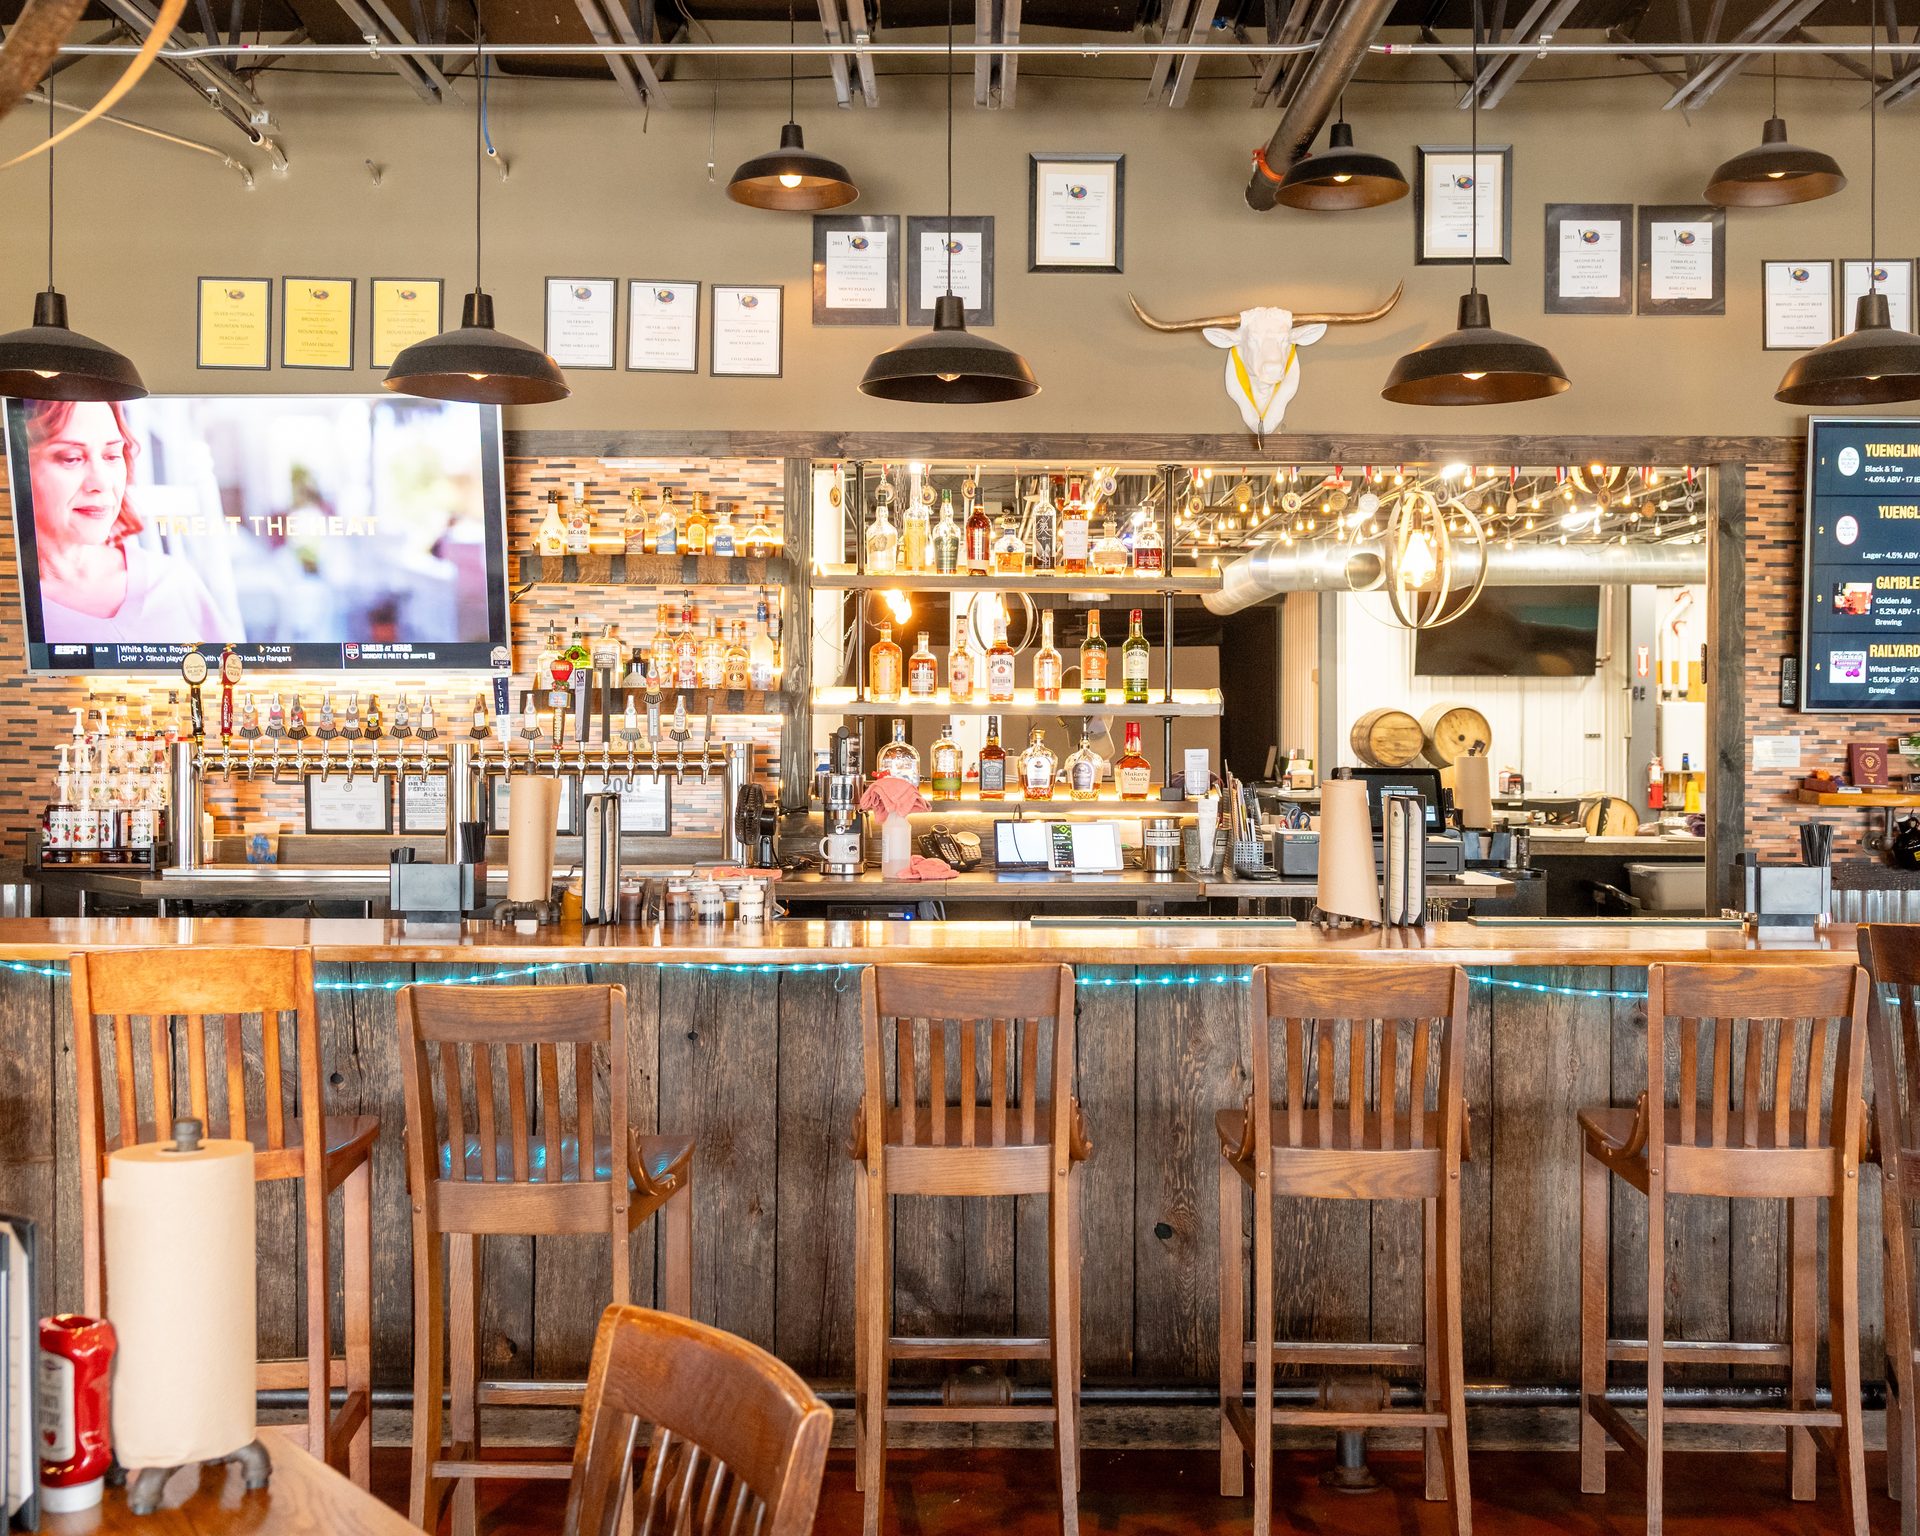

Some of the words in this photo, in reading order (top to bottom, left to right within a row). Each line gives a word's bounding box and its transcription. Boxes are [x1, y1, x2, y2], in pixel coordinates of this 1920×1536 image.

[154, 515, 241, 537] TREAT
[249, 516, 299, 537] THE
[311, 516, 378, 537] HEAT
[1818, 526, 1824, 534] 2
[1862, 552, 1882, 560] Lager
[1876, 576, 1920, 590] GAMBLE
[1816, 594, 1822, 603] 3
[1875, 597, 1899, 605] Golden
[1899, 597, 1912, 605] Ale
[54, 645, 87, 655] ESPN
[120, 645, 142, 653] White
[143, 645, 157, 653] Sox
[1126, 650, 1148, 658] JAMESON
[257, 655, 265, 664] by
[266, 655, 292, 664] Rangers
[1814, 663, 1821, 671] 4
[1869, 665, 1890, 673] Wheat
[1891, 665, 1906, 673] Beer
[1868, 687, 1896, 695] Brewing
